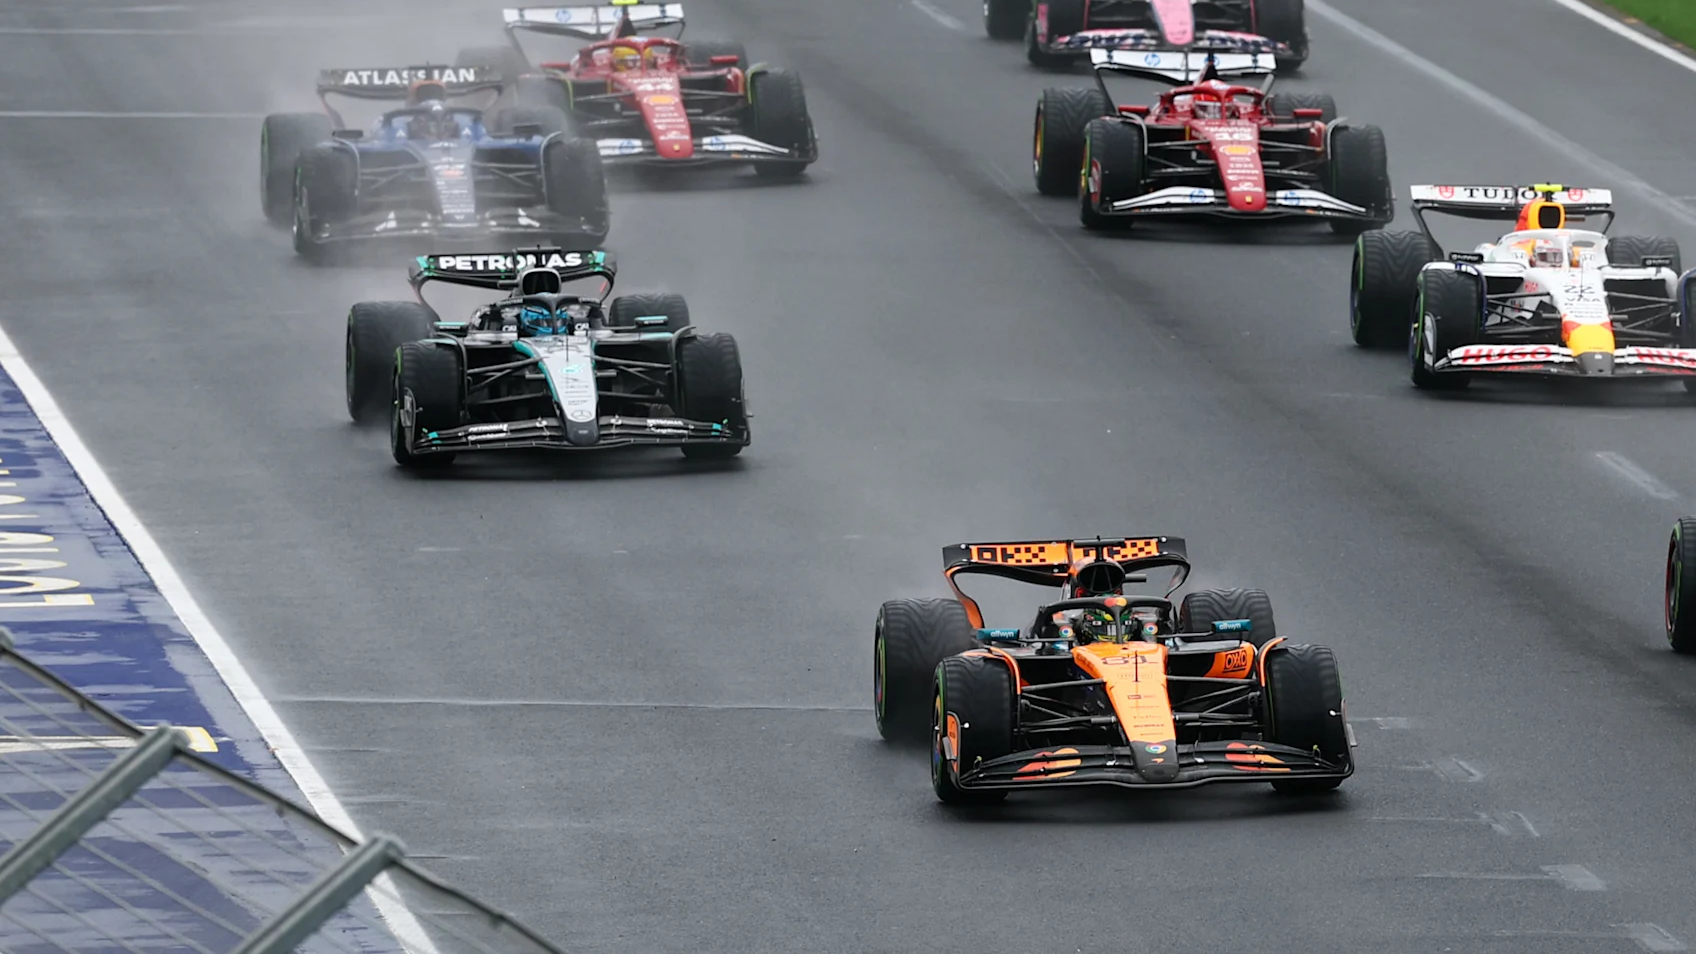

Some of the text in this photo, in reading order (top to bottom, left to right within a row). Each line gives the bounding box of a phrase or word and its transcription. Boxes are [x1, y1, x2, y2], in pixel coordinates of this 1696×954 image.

[438, 252, 583, 271] PETRONAS
[1460, 344, 1553, 364] HUGO
[1225, 649, 1248, 669] OXXO
